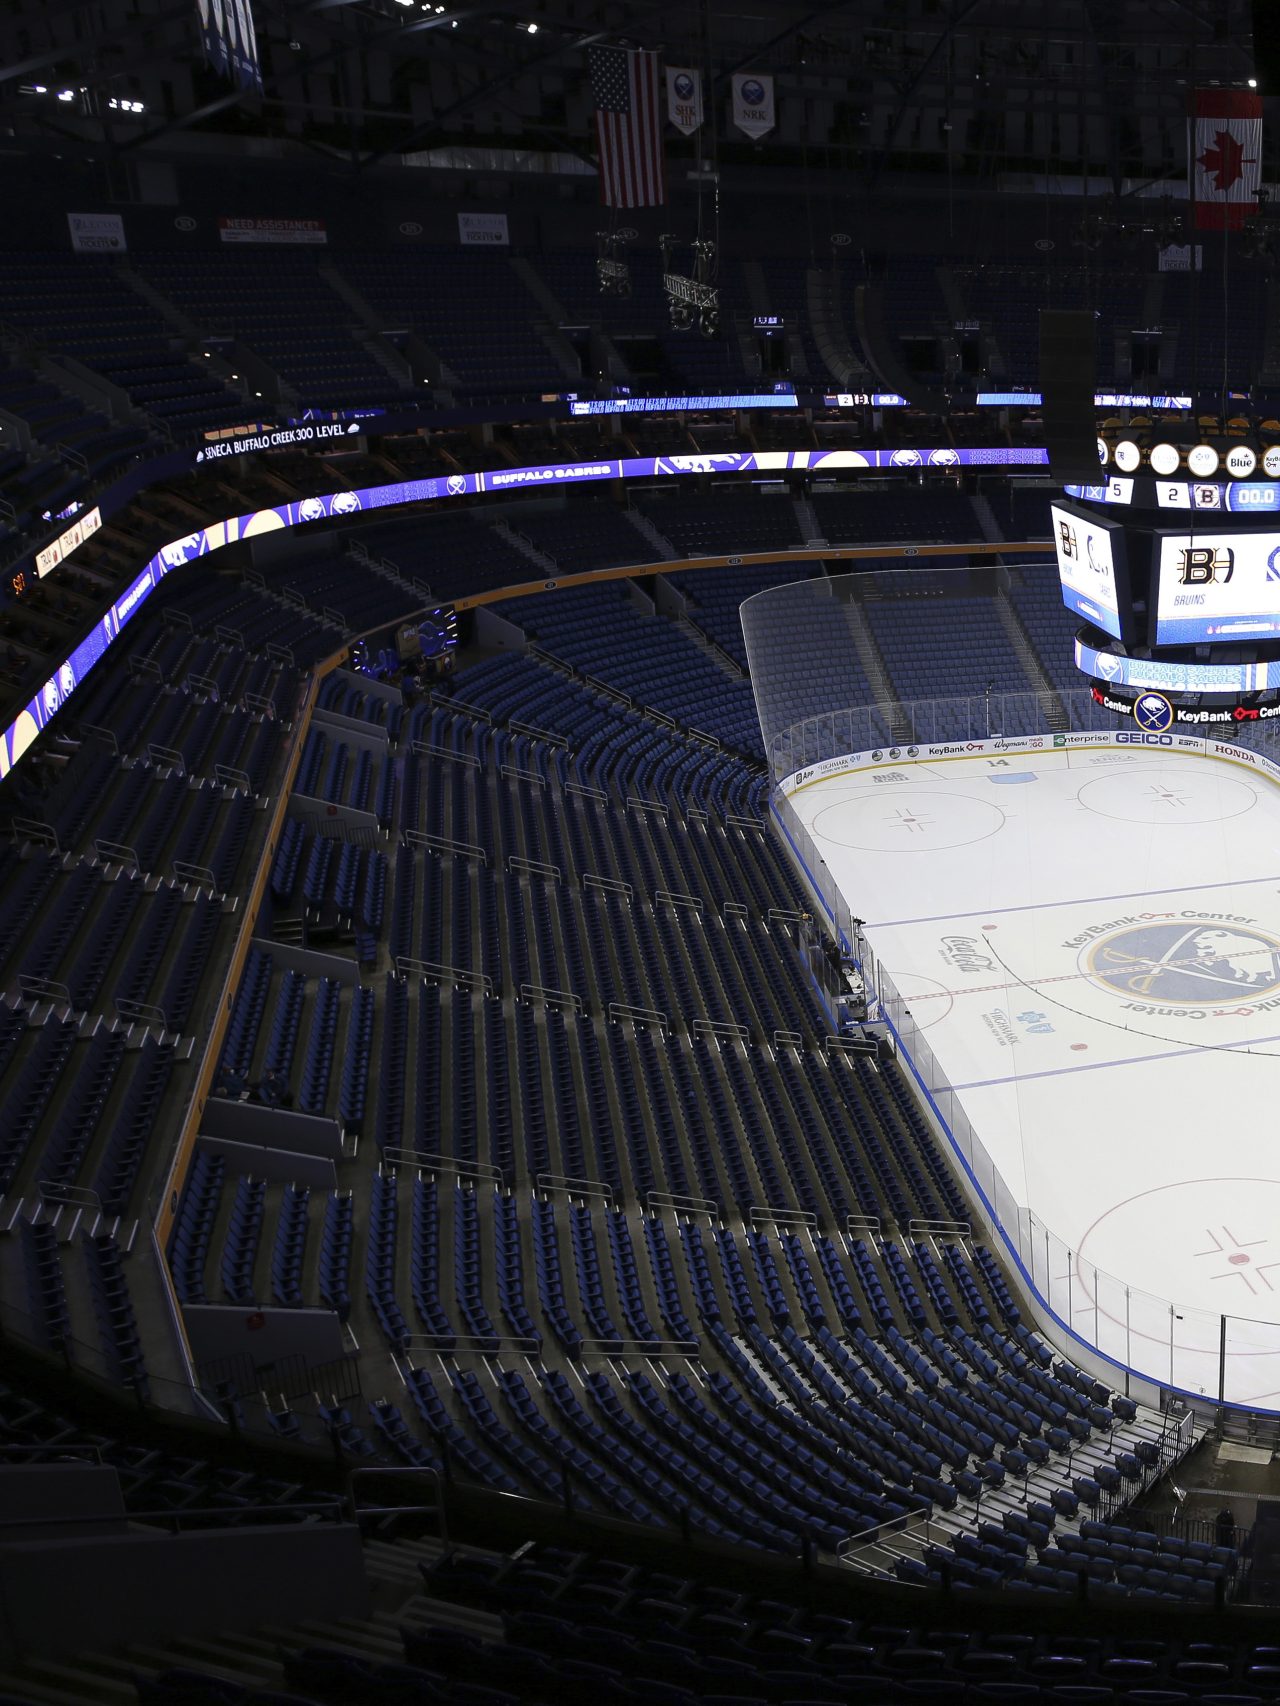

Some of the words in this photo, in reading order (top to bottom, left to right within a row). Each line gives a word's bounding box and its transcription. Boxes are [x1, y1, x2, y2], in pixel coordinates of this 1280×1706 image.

[743, 110, 766, 121] NRK
[226, 219, 254, 229] NEED
[205, 444, 232, 460] SENECA
[234, 436, 270, 453] BUFFALO
[271, 430, 296, 445] CREEK
[296, 427, 313, 441] 300
[316, 425, 344, 438] LEVEL
[1230, 458, 1252, 468] Blue
[492, 470, 553, 485] BUFFALO
[555, 465, 611, 478] SABRES
[1113, 484, 1121, 497] 5
[1168, 488, 1178, 501] 2
[1238, 488, 1275, 504] 00.0
[1173, 594, 1206, 607] BRUINS
[1104, 697, 1132, 714] Center
[1177, 710, 1232, 725] KeyBank
[993, 739, 1027, 751] Wegmans
[1056, 735, 1109, 744] enterprise
[1115, 733, 1173, 746] GEICO
[929, 745, 965, 755] KeyBank
[1214, 744, 1256, 764] HONDA
[818, 758, 849, 771] HIGHMARK
[986, 759, 1010, 767] 14
[1061, 914, 1139, 949] KeyBank
[1180, 910, 1258, 924] Center
[1120, 1001, 1207, 1020] Center
[990, 1008, 1022, 1045] HIGHMARK
